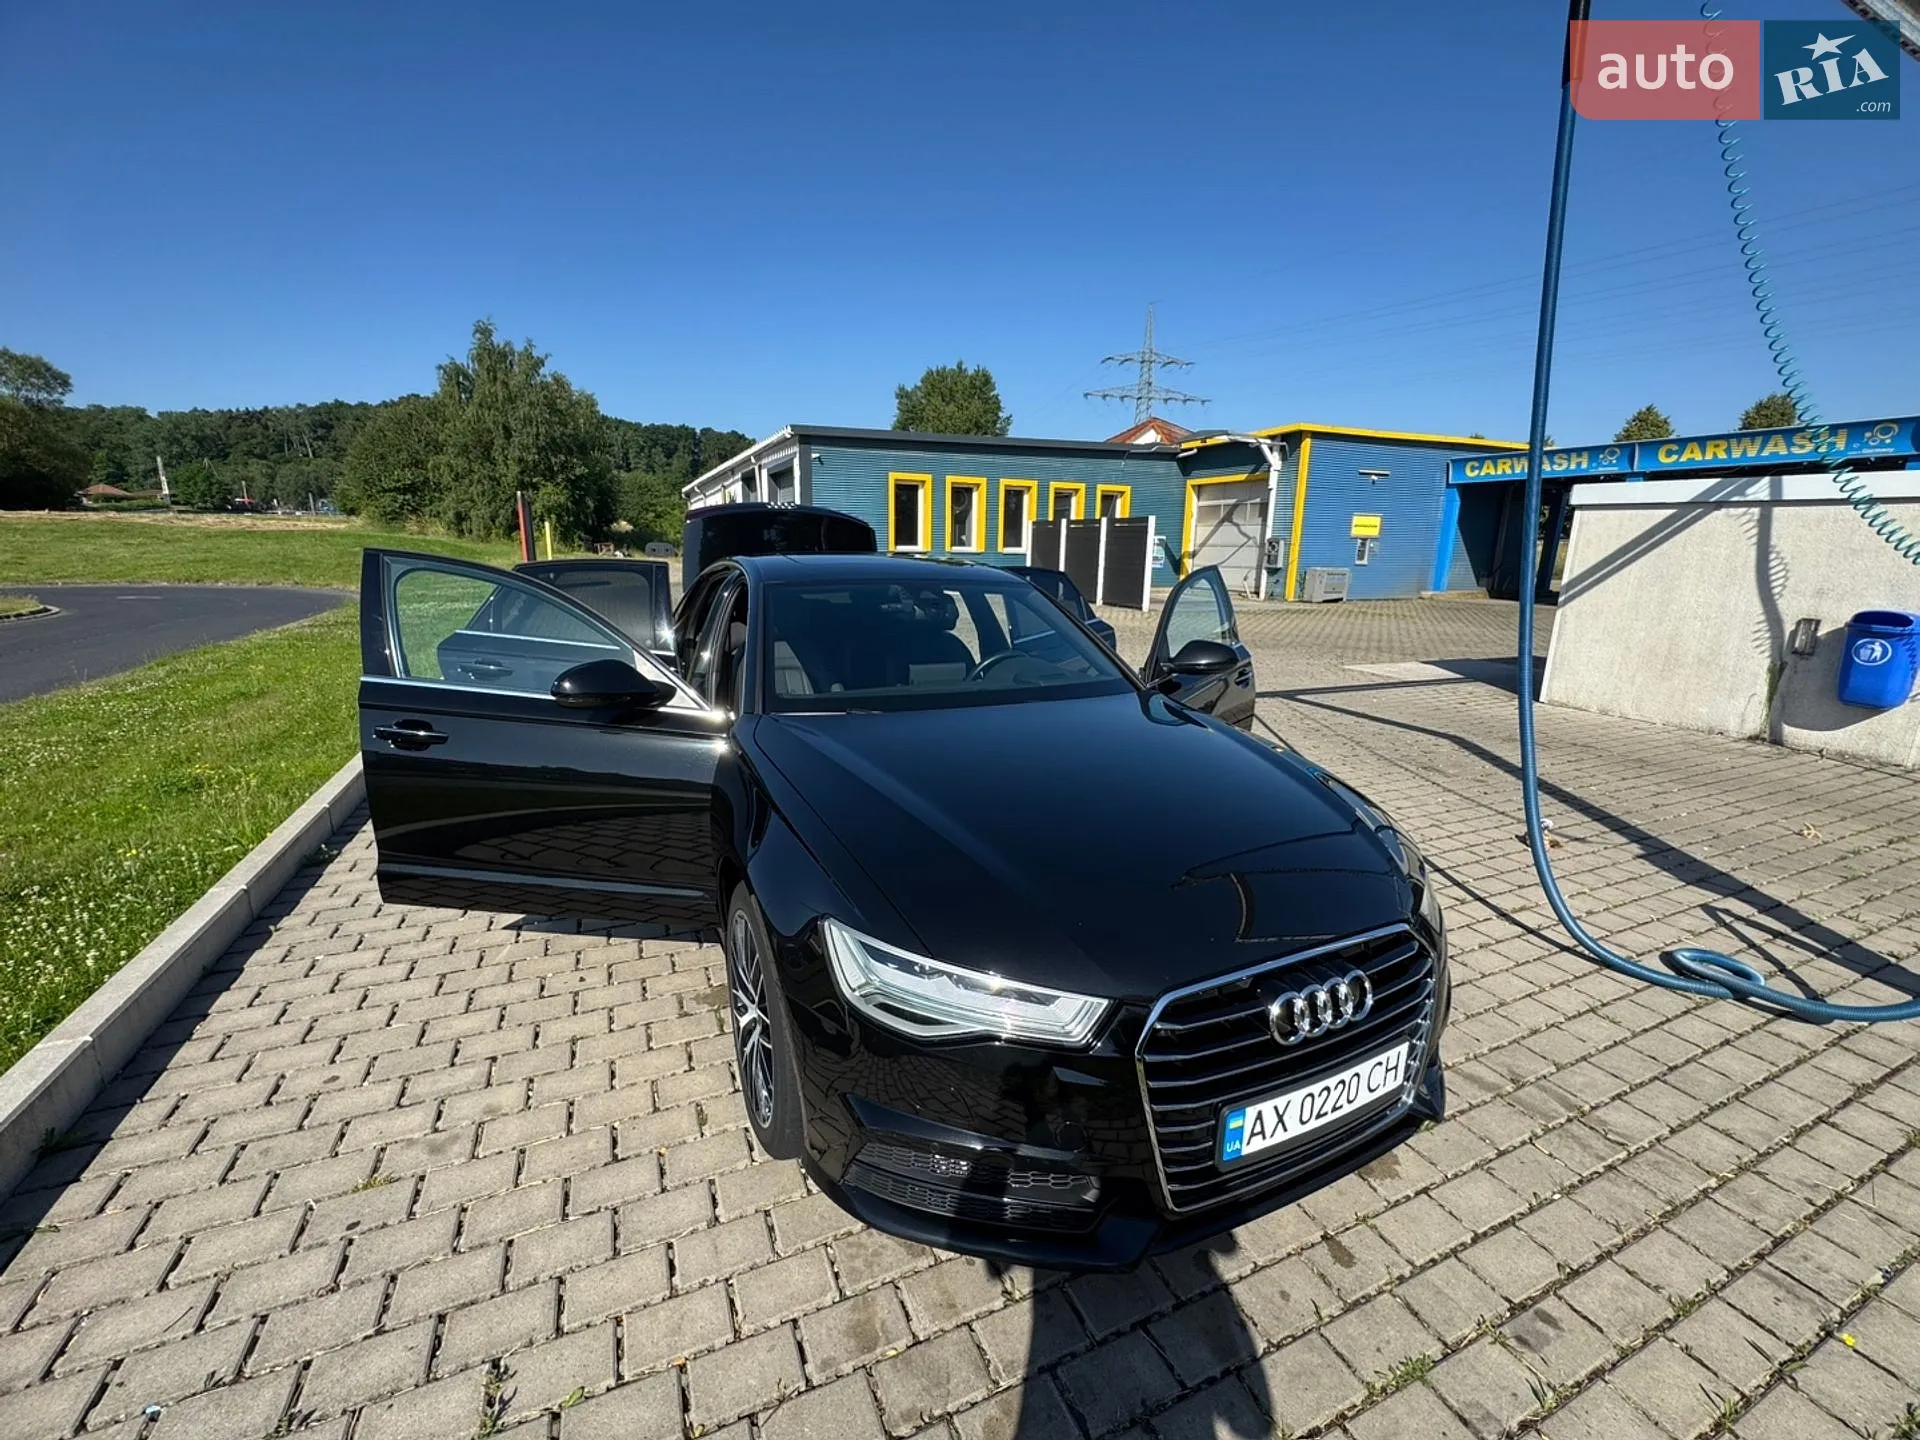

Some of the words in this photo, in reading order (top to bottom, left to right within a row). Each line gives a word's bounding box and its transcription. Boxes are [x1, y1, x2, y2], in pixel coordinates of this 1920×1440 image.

[1657, 429, 1848, 464] CARWASH
[1245, 1099, 1292, 1146] AX
[1298, 1071, 1361, 1126] 0220
[1366, 1050, 1401, 1094] CH
[1226, 1140, 1242, 1153] UA
